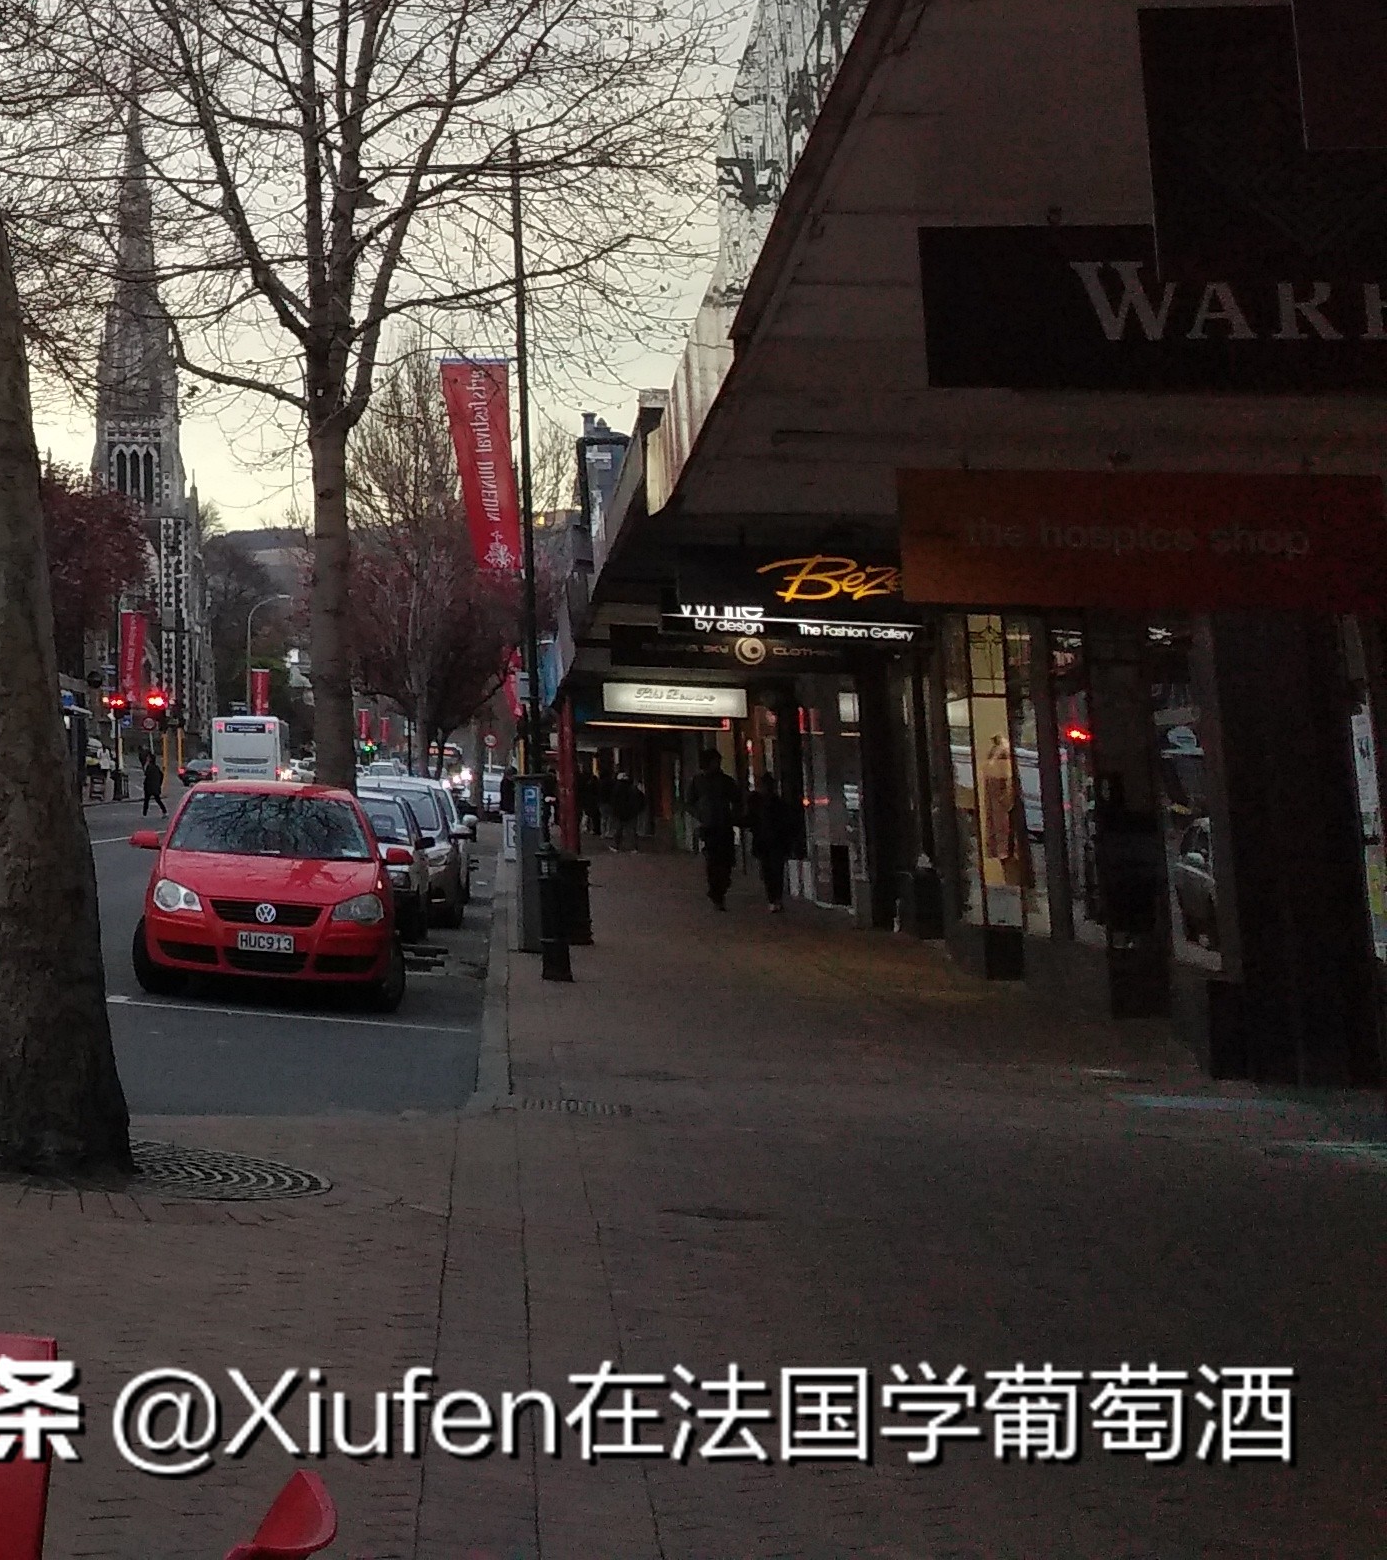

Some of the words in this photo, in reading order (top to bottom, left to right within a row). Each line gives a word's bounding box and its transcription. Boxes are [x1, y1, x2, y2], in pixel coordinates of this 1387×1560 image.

[694, 617, 712, 633] by
[718, 616, 765, 634] design
[798, 623, 820, 637] The
[821, 624, 870, 640] Fashion
[871, 627, 915, 643] Gallery
[239, 933, 292, 951] HUC913
